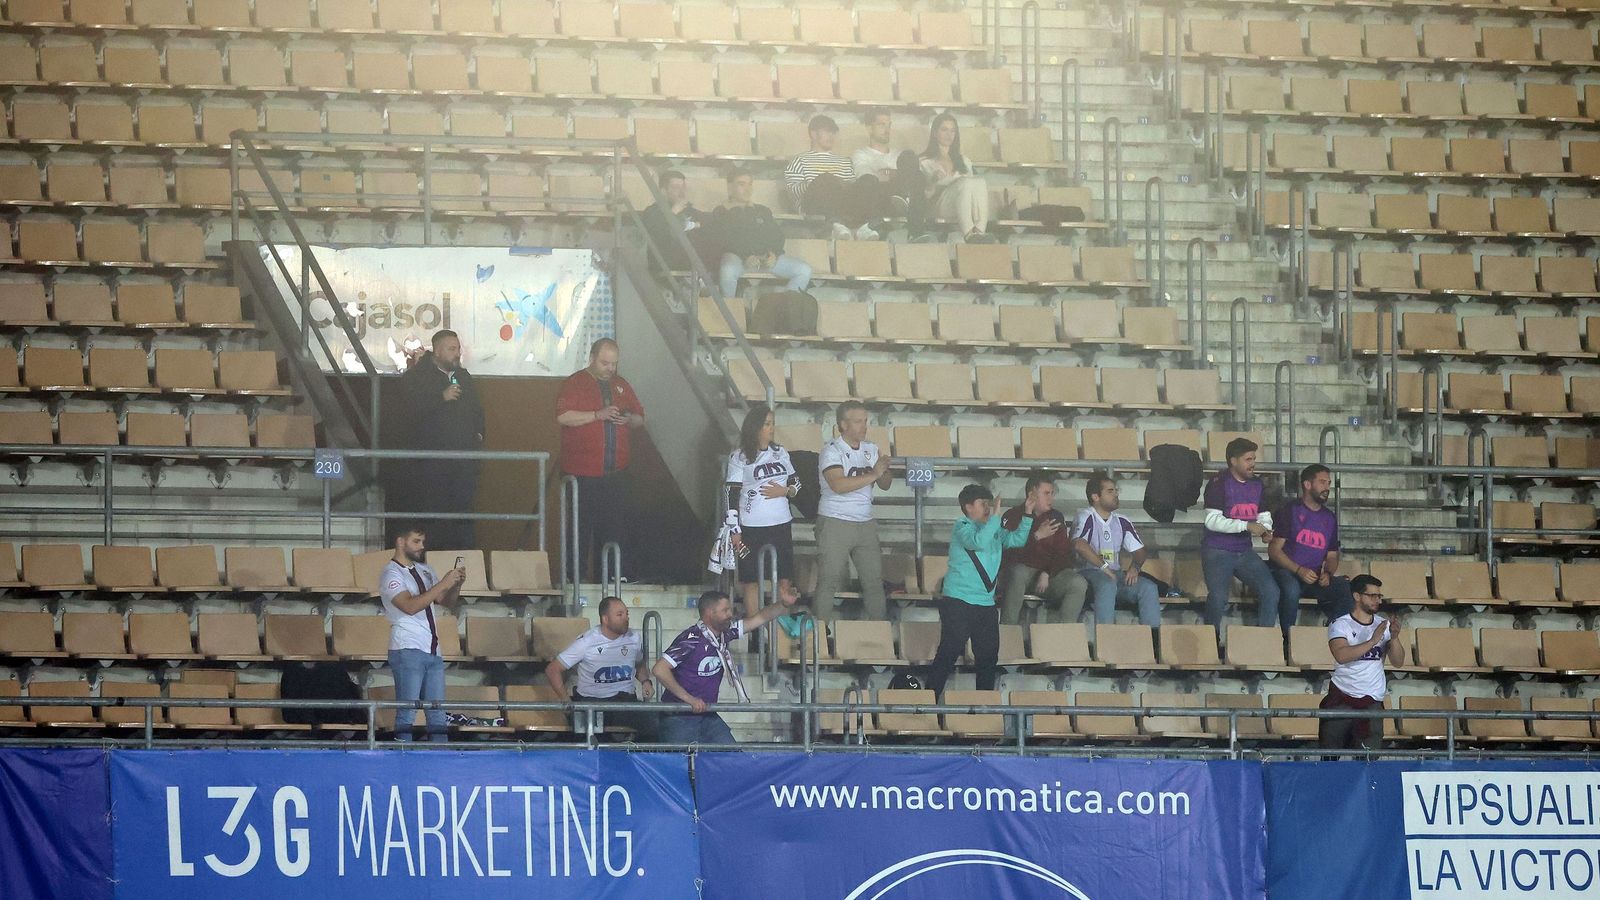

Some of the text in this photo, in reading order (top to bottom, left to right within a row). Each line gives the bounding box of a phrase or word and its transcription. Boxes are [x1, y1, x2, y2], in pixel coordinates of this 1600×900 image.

[316, 461, 341, 474] 230
[908, 469, 932, 482] 229
[770, 781, 1191, 815] www.macromatica.com
[1415, 783, 1600, 826] VIPSUALI
[166, 784, 645, 877] L3G MARKETING.
[1415, 848, 1600, 892] LA VICTO
